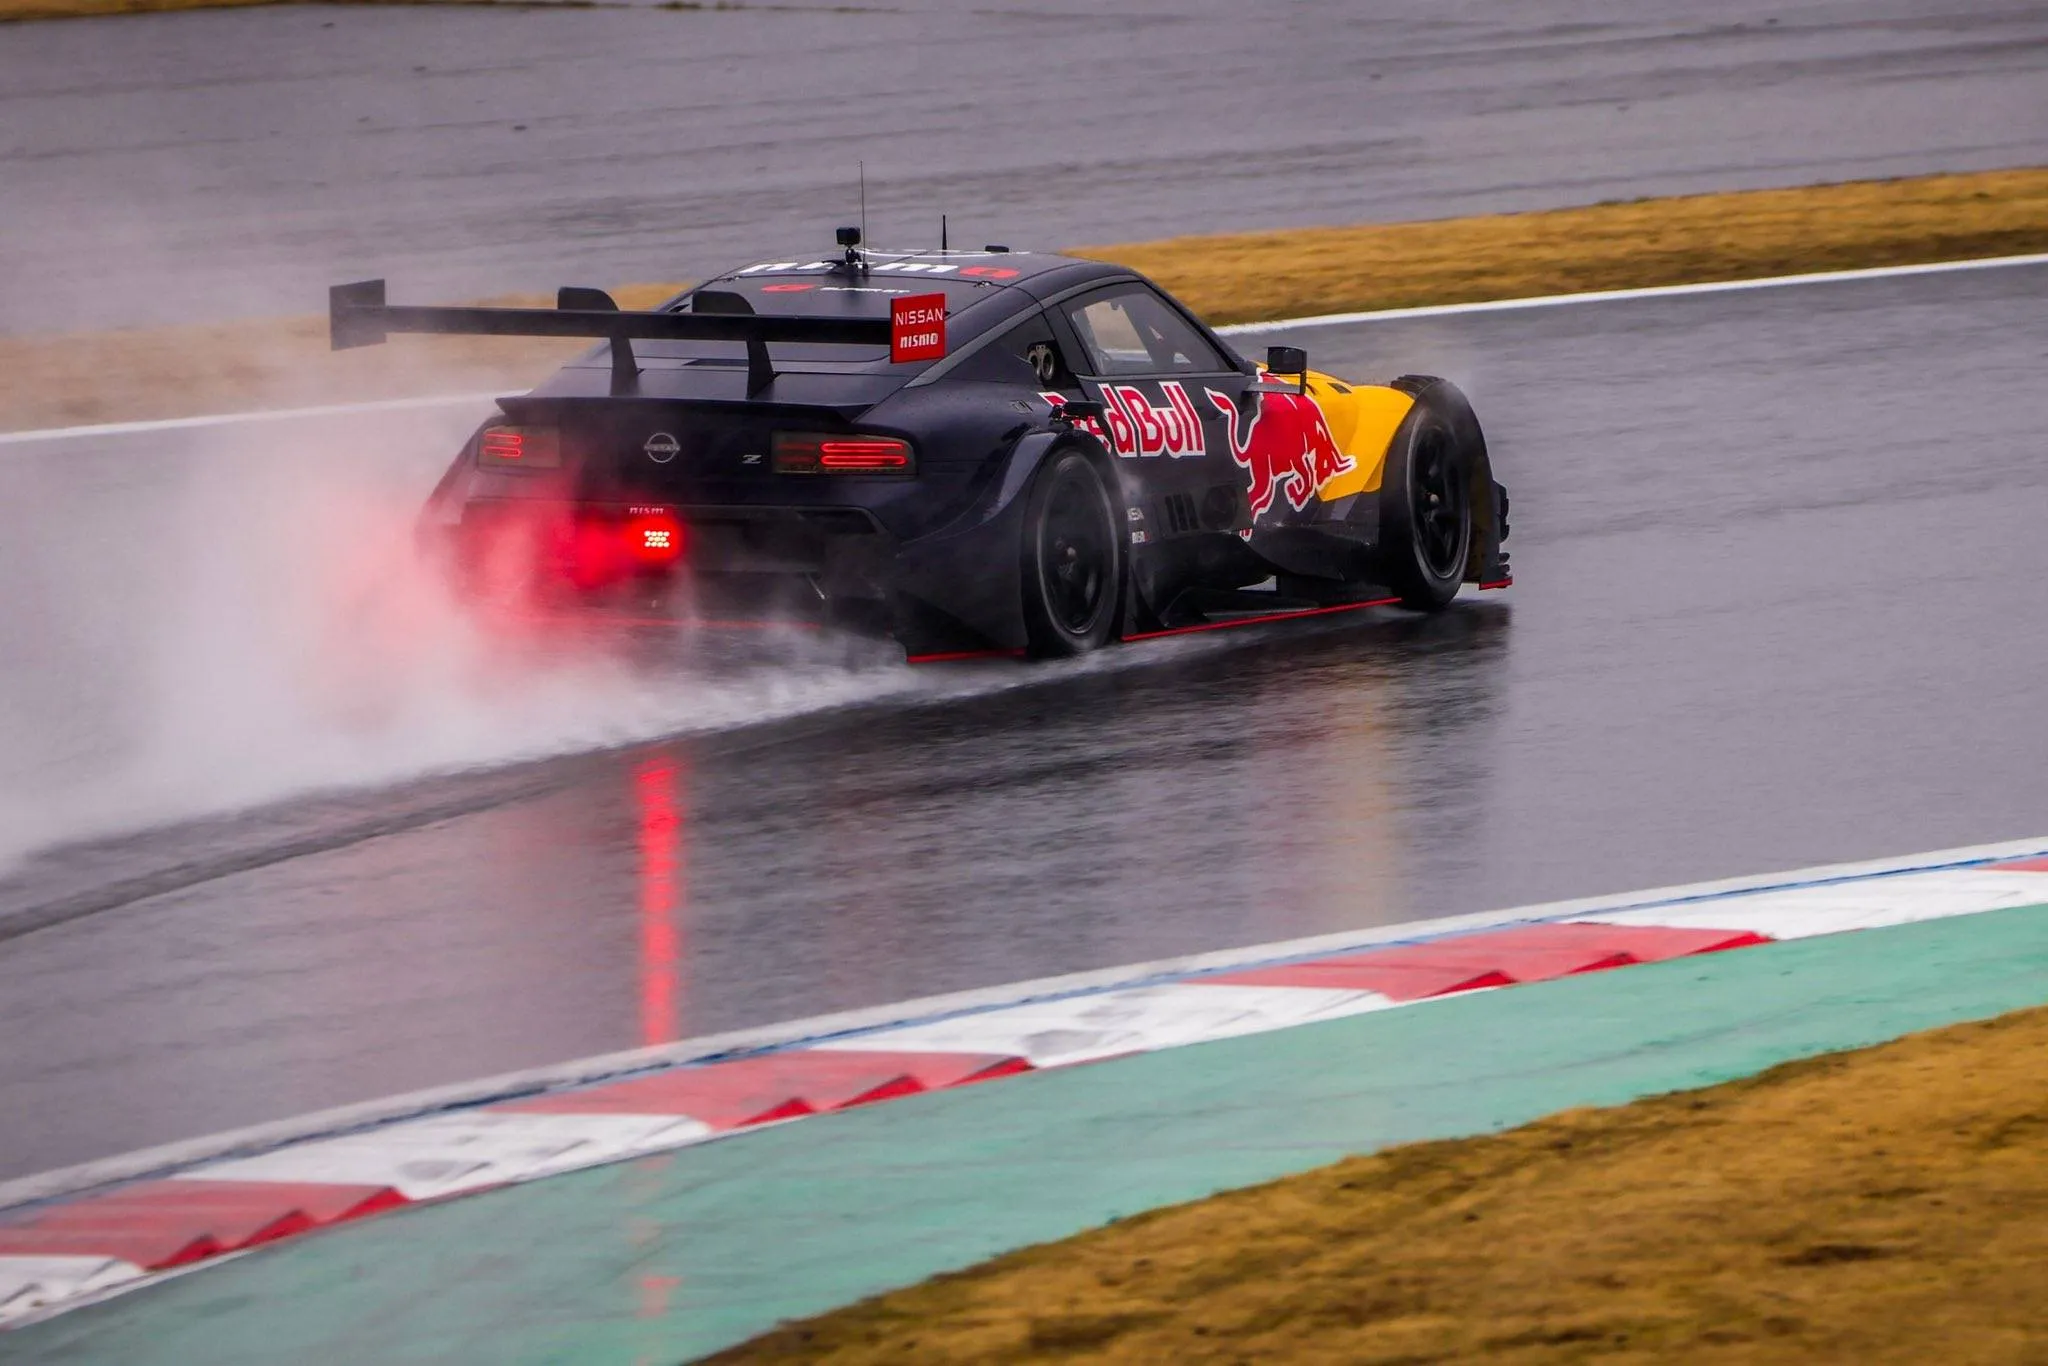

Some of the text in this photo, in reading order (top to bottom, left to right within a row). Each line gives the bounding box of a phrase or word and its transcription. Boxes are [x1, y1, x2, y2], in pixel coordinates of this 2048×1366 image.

[895, 307, 944, 327] NISSAN
[900, 332, 939, 349] nismo
[1114, 381, 1206, 460] Bull
